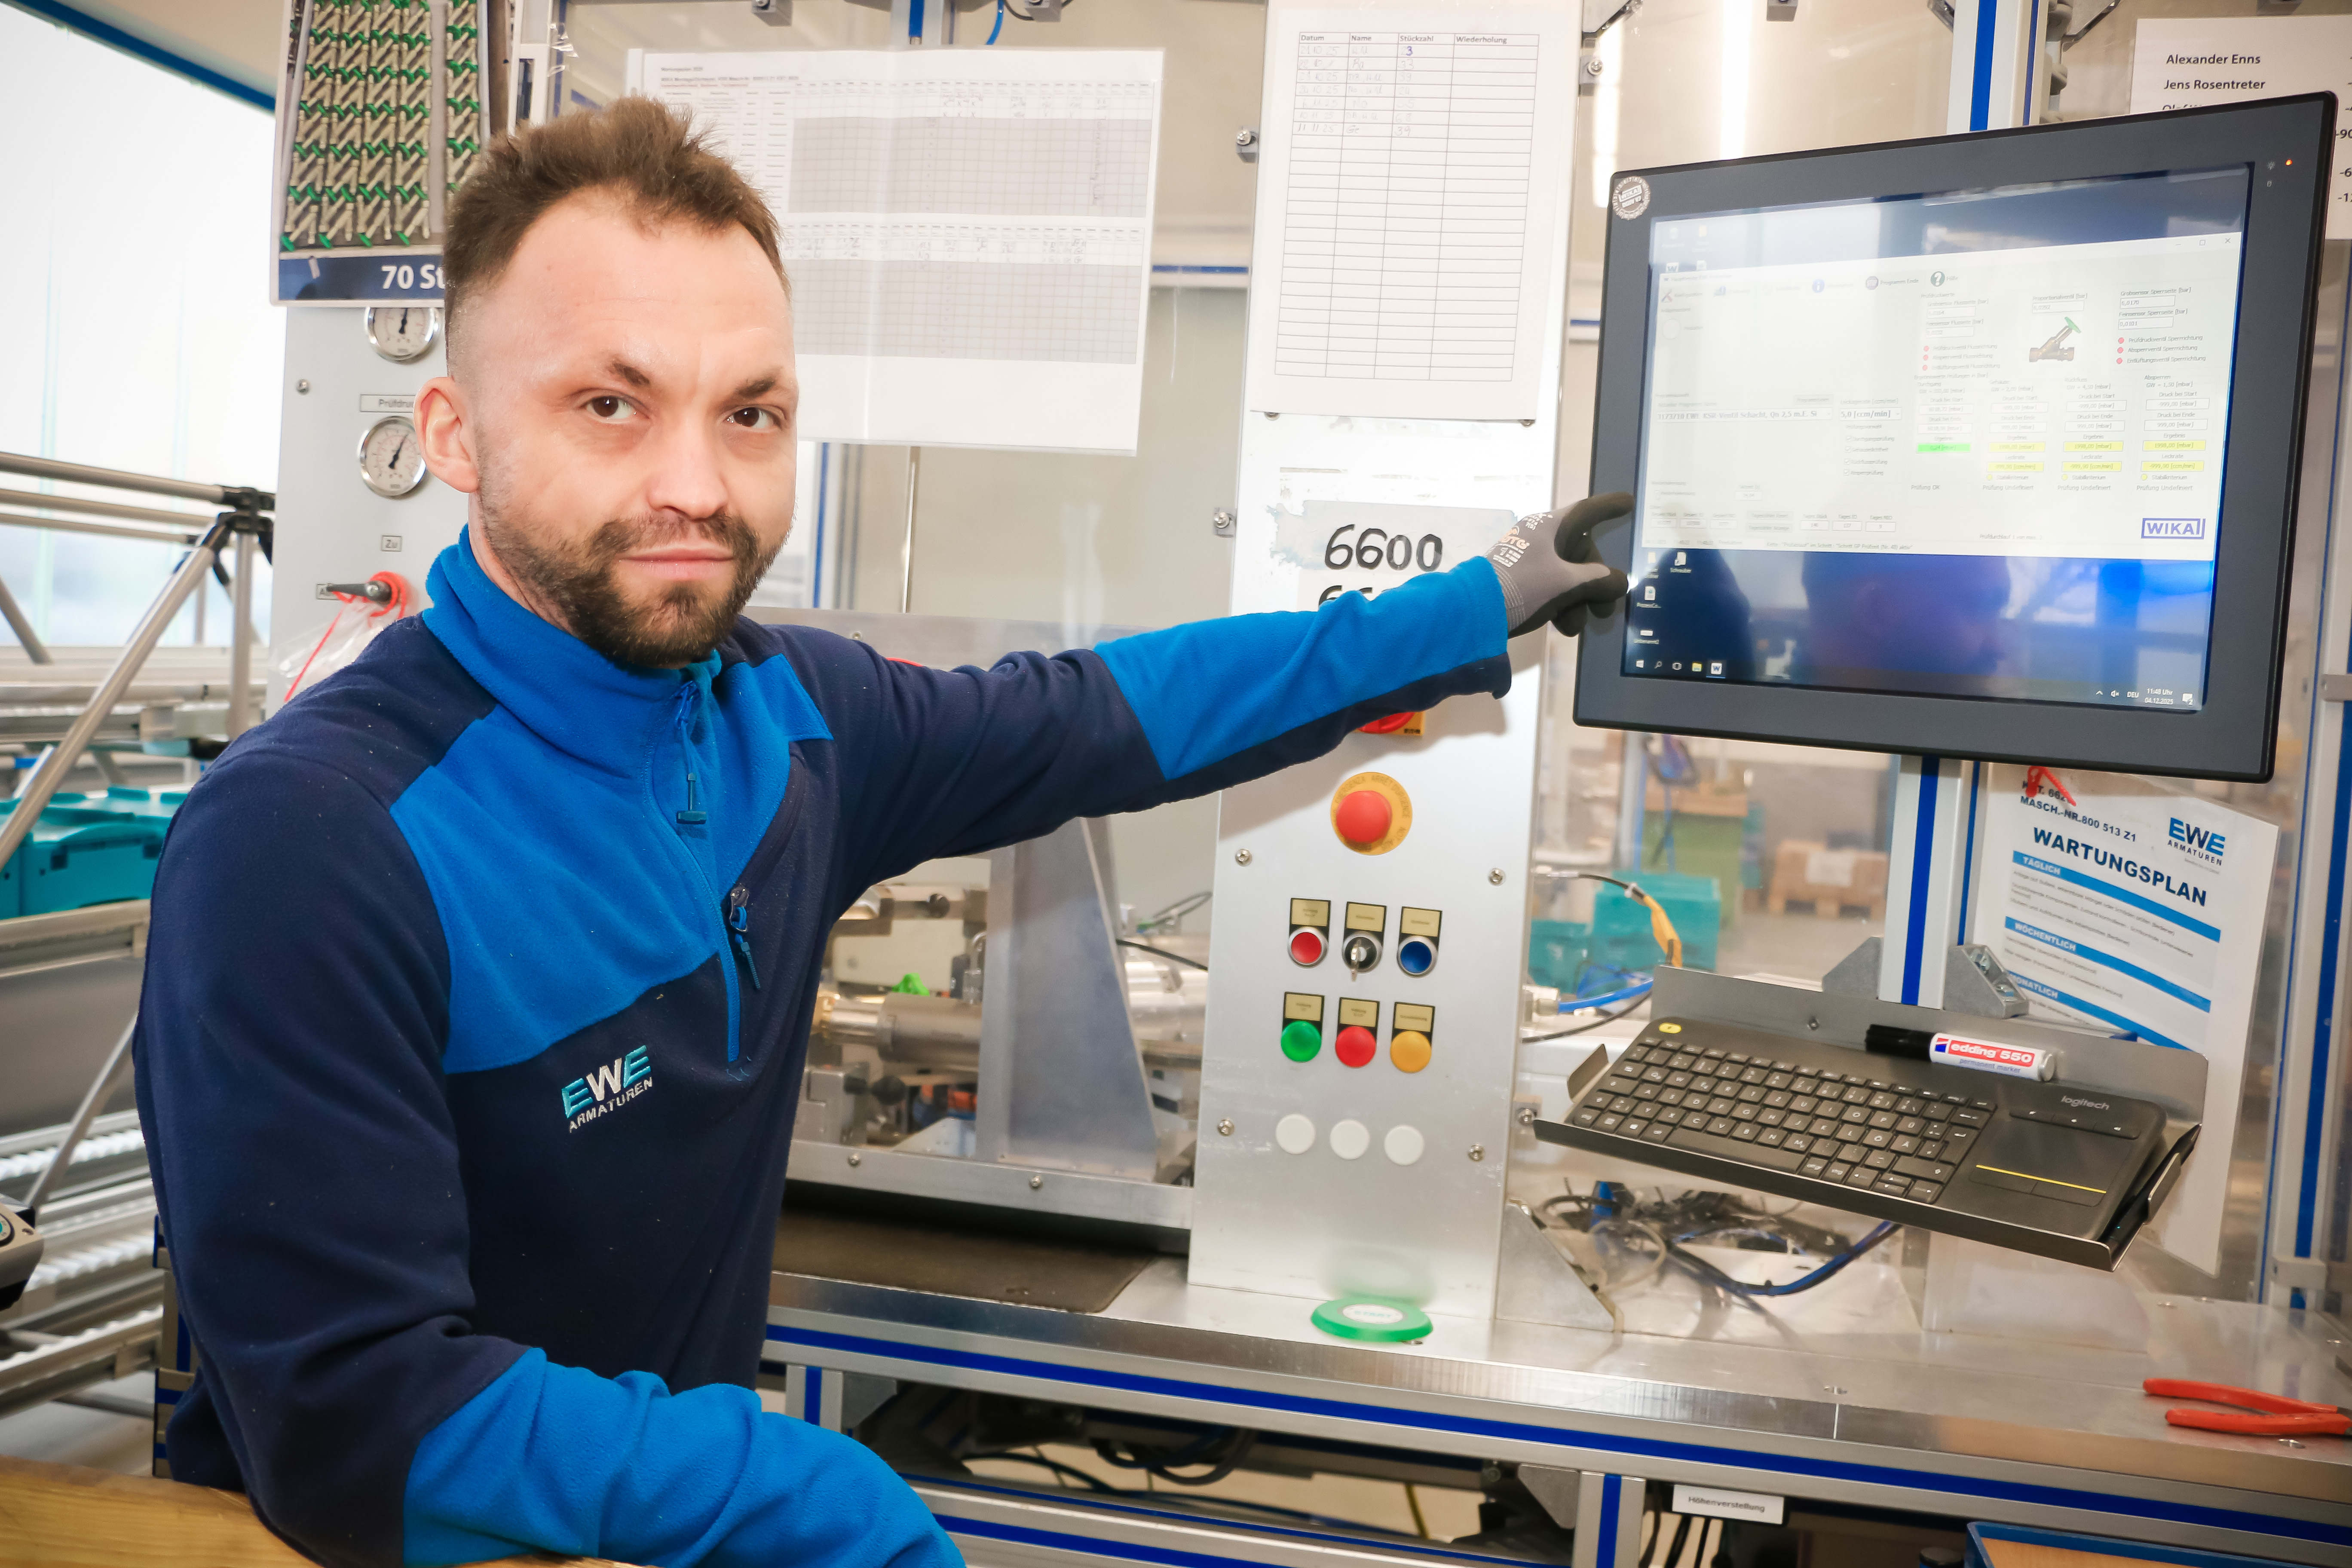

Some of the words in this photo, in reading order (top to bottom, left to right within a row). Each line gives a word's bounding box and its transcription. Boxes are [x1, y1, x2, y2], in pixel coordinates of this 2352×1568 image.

[2166, 54, 2228, 64] Alexander
[2232, 54, 2261, 64] Enns
[2164, 79, 2190, 90] Jens
[2193, 79, 2266, 90] Rosentreter
[382, 265, 414, 289] 70
[2146, 522, 2193, 536] WIKA
[1325, 524, 1442, 572] 6600
[2103, 823, 2121, 836] 513
[2124, 830, 2137, 843] Z1
[2168, 816, 2226, 857] EWE
[2167, 839, 2223, 867] ARMATUREN
[2023, 856, 2061, 876] TÄGLICH
[2033, 826, 2207, 907] WARTUNGSPLAN
[2015, 922, 2076, 951] WÖCHENTLICH
[1951, 1042, 1997, 1059] edding
[1998, 1050, 2032, 1063] 550
[1959, 1058, 1995, 1069] permanent
[1997, 1066, 2021, 1074] marker
[561, 1045, 651, 1118] EWE
[569, 1077, 652, 1133] ARMATUREN
[2061, 1096, 2109, 1110] logitech
[1688, 1496, 1765, 1513] Höhenverstellung
